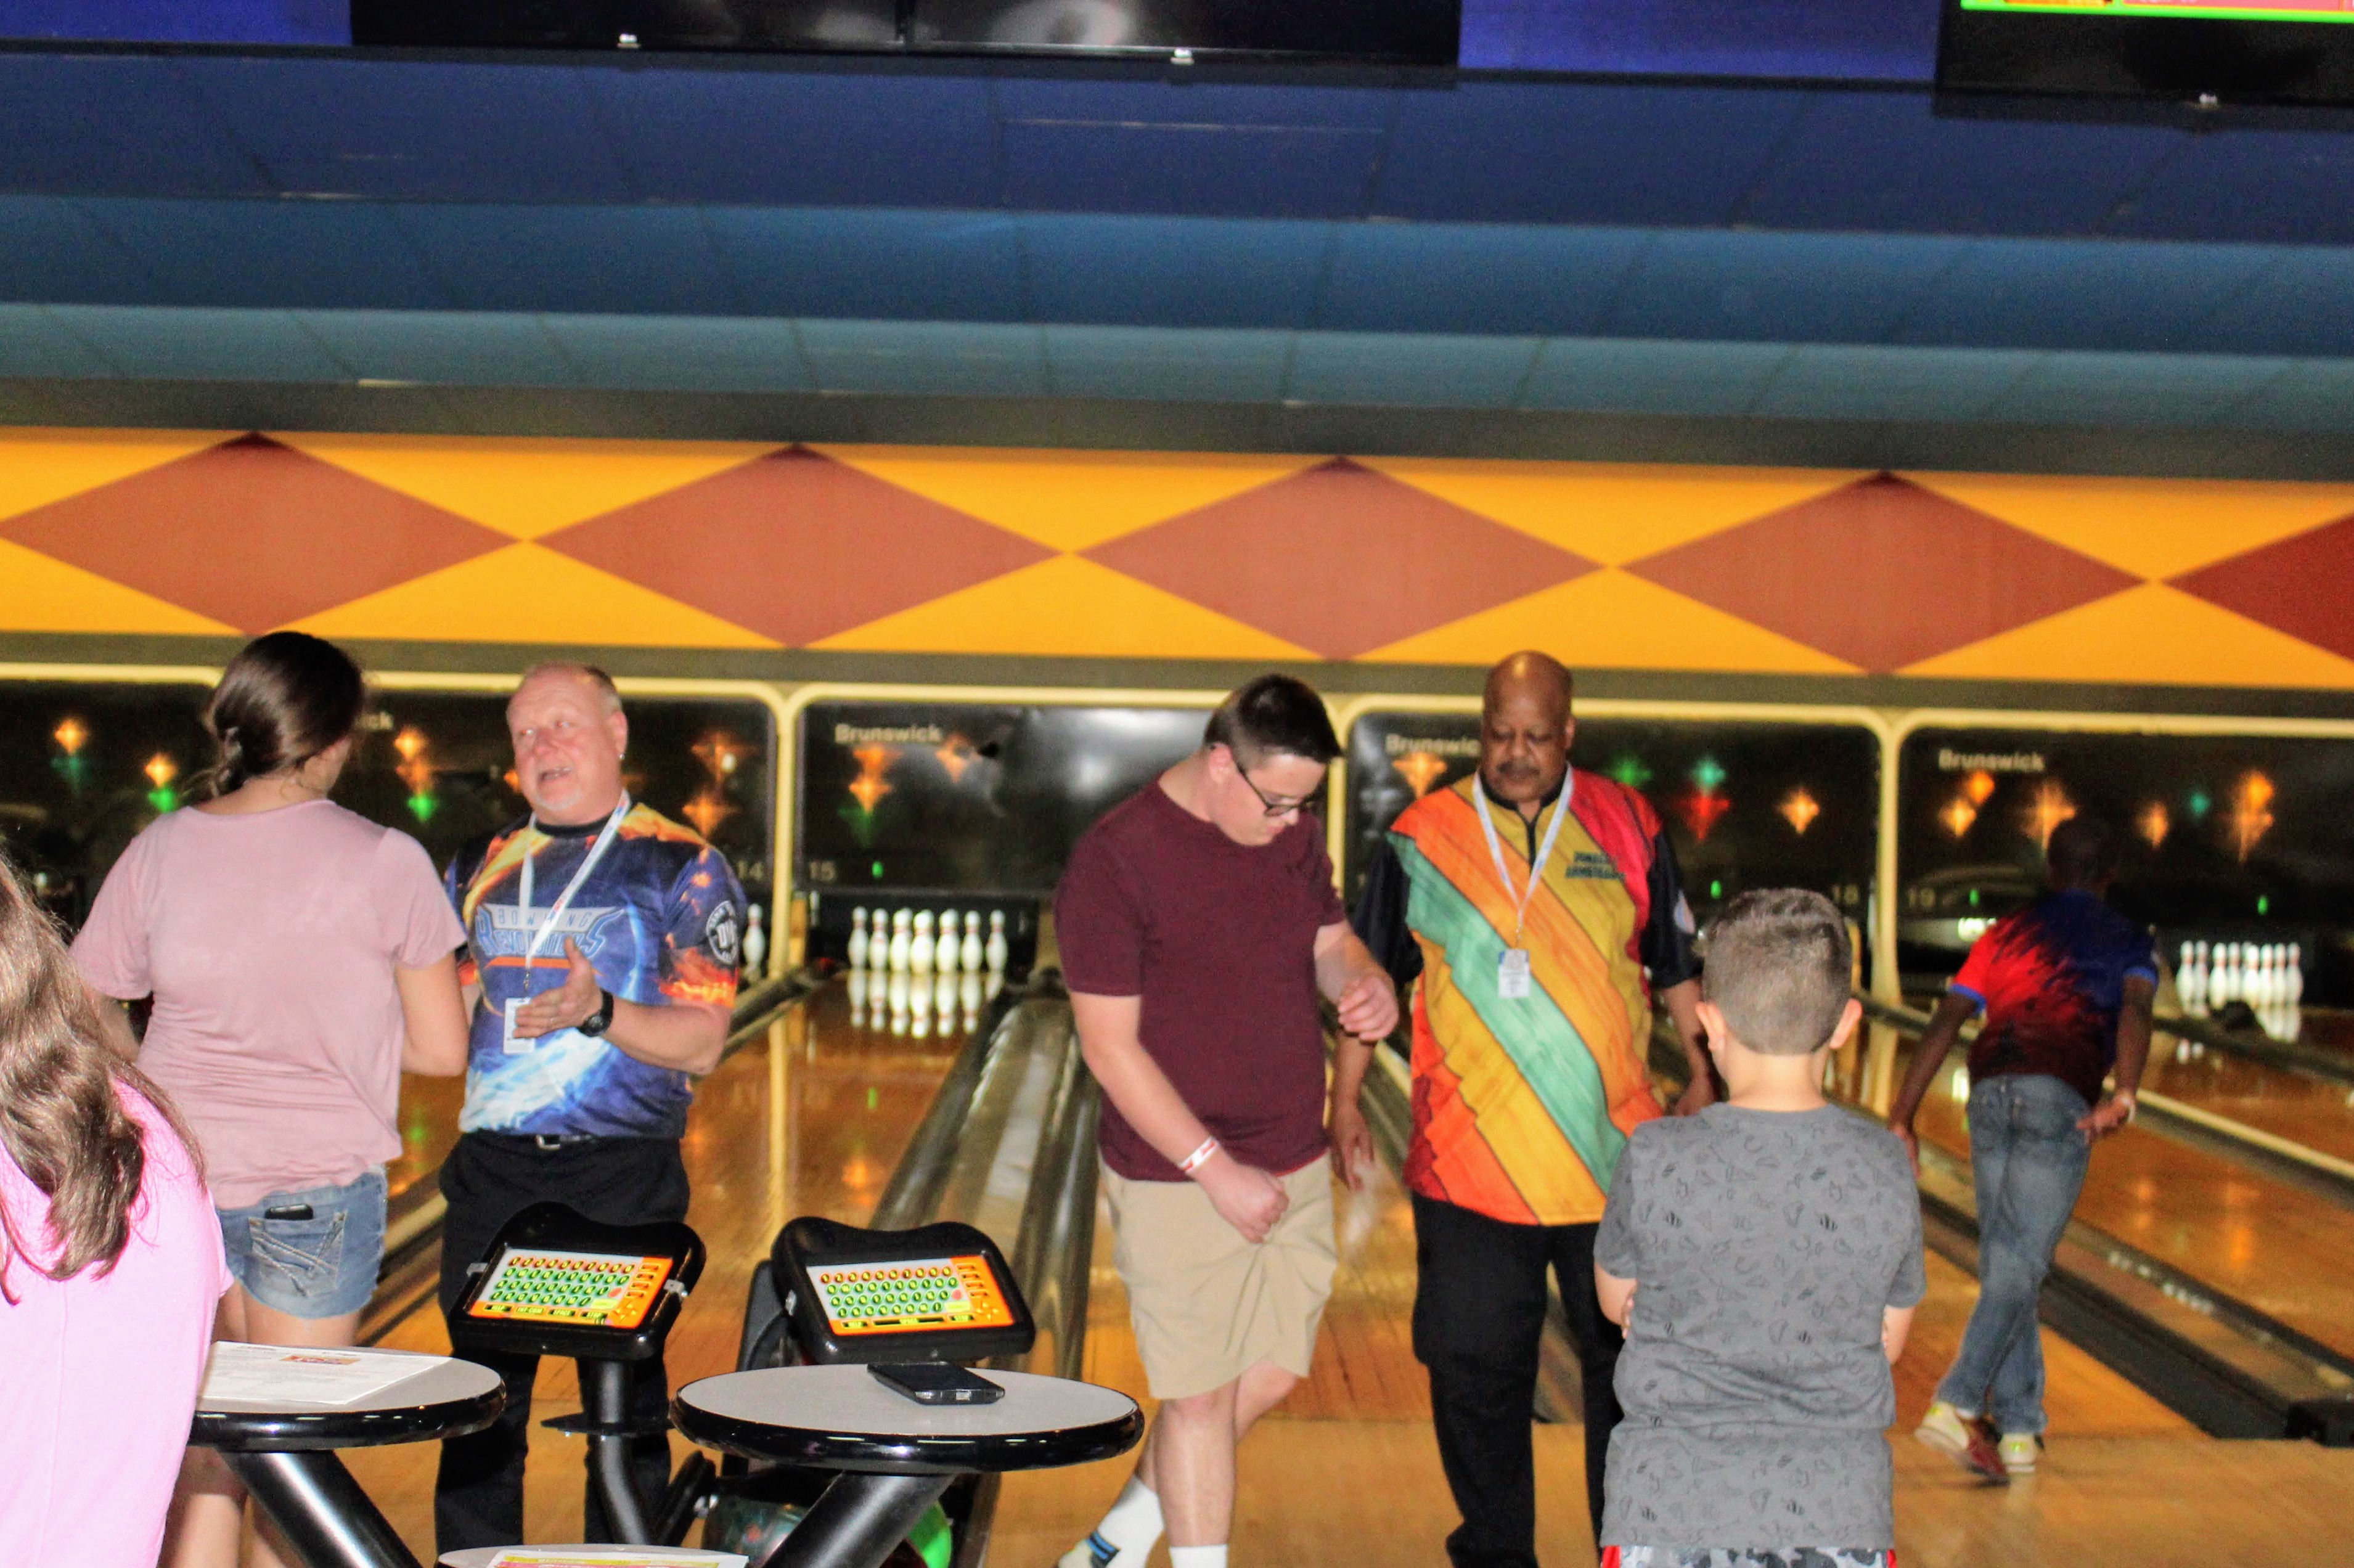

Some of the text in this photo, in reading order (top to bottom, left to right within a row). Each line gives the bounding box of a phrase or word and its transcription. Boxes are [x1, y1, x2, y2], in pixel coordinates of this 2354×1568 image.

[835, 724, 941, 743] Brunswick
[1386, 733, 1481, 757] Brunswic
[1939, 749, 2045, 771] Brunswick
[810, 860, 836, 880] 15
[498, 909, 592, 926] BOWNG
